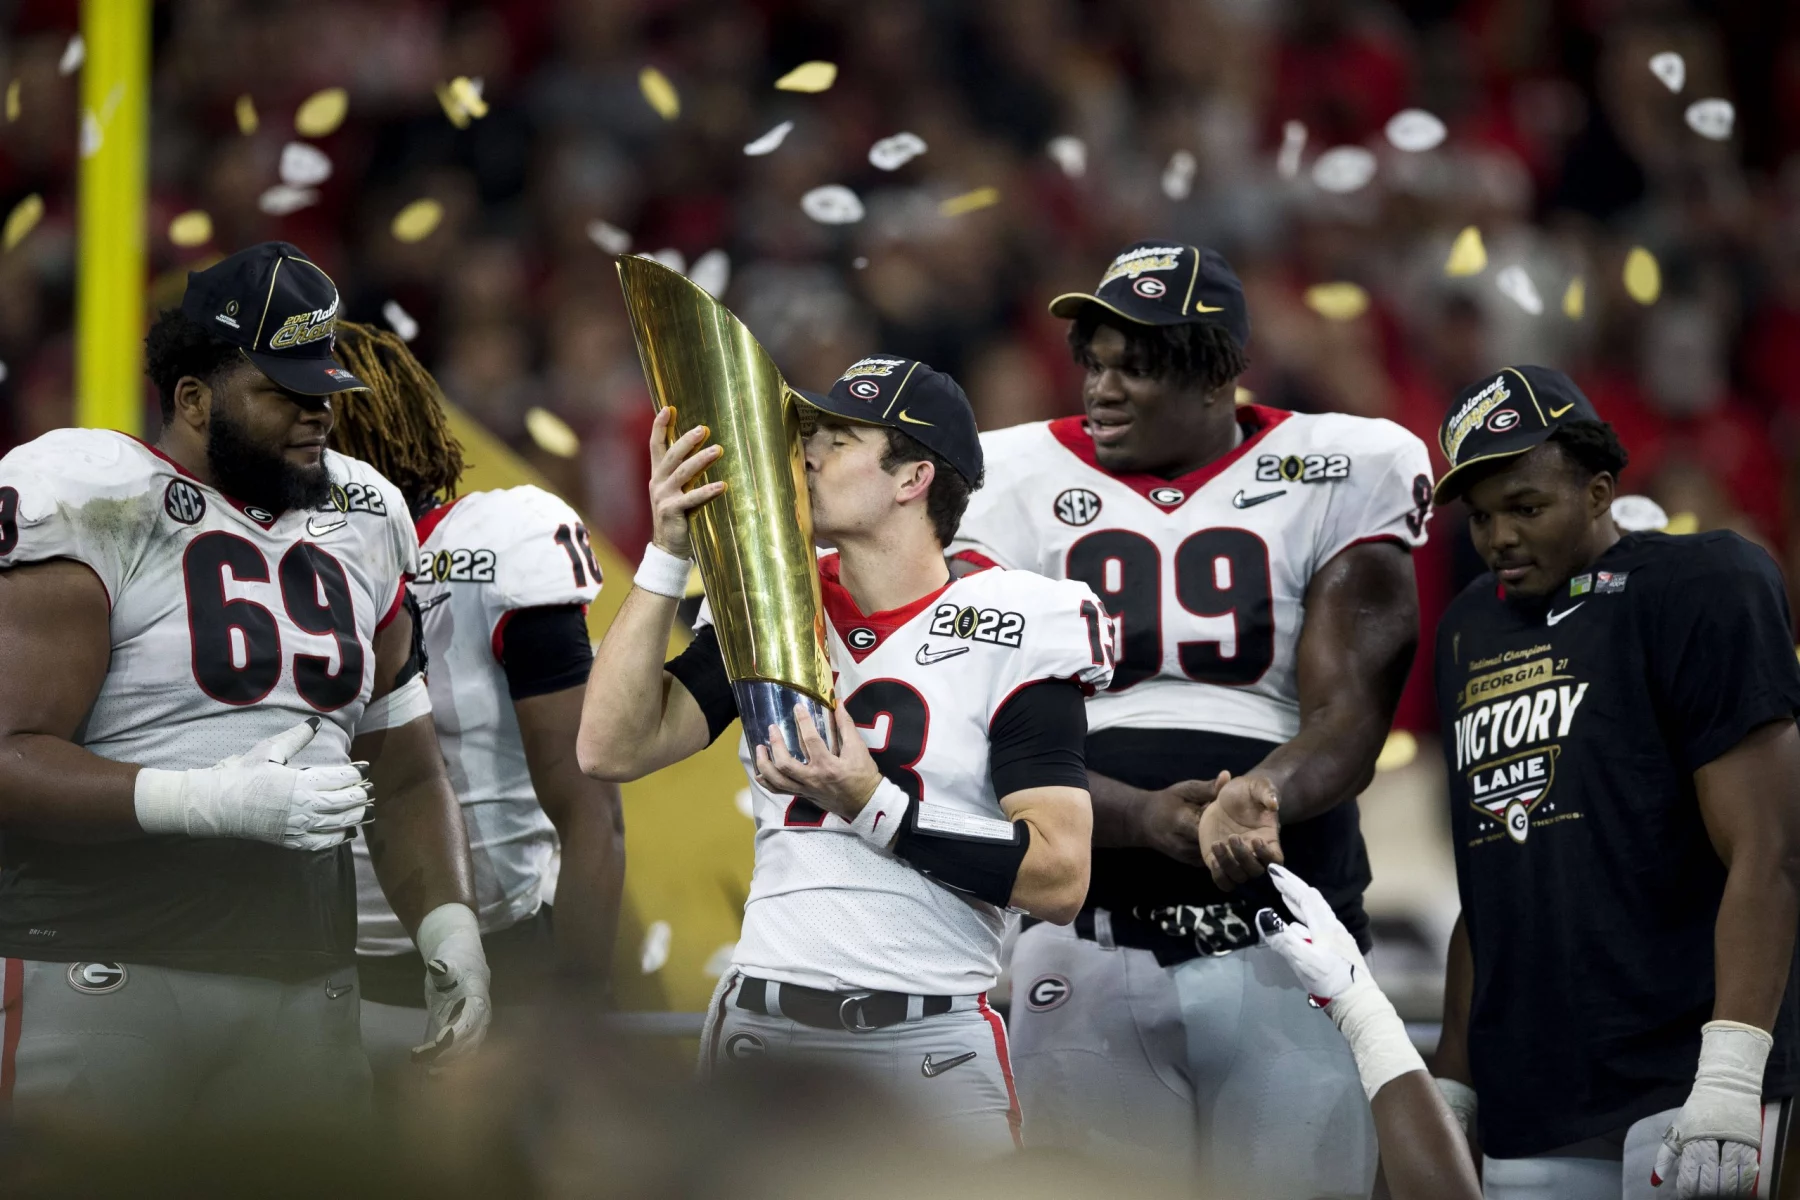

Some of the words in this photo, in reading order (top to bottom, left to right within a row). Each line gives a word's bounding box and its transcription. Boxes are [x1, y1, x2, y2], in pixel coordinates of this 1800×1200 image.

[284, 312, 311, 326] 2021
[1256, 454, 1350, 483] 2022
[167, 481, 203, 522] SEC
[1057, 491, 1098, 525] SEC
[413, 549, 496, 584] 2022
[183, 530, 364, 712] 69
[929, 603, 1026, 649] 2022
[1066, 527, 1275, 692] 99
[1468, 652, 1502, 672] National
[1503, 643, 1552, 662] Champions
[1555, 658, 1569, 671] 21
[1470, 664, 1545, 696] GEORGIA
[1455, 682, 1589, 772] VICTORY
[1473, 756, 1545, 795] LANE
[28, 928, 57, 937] DRI-FIT
